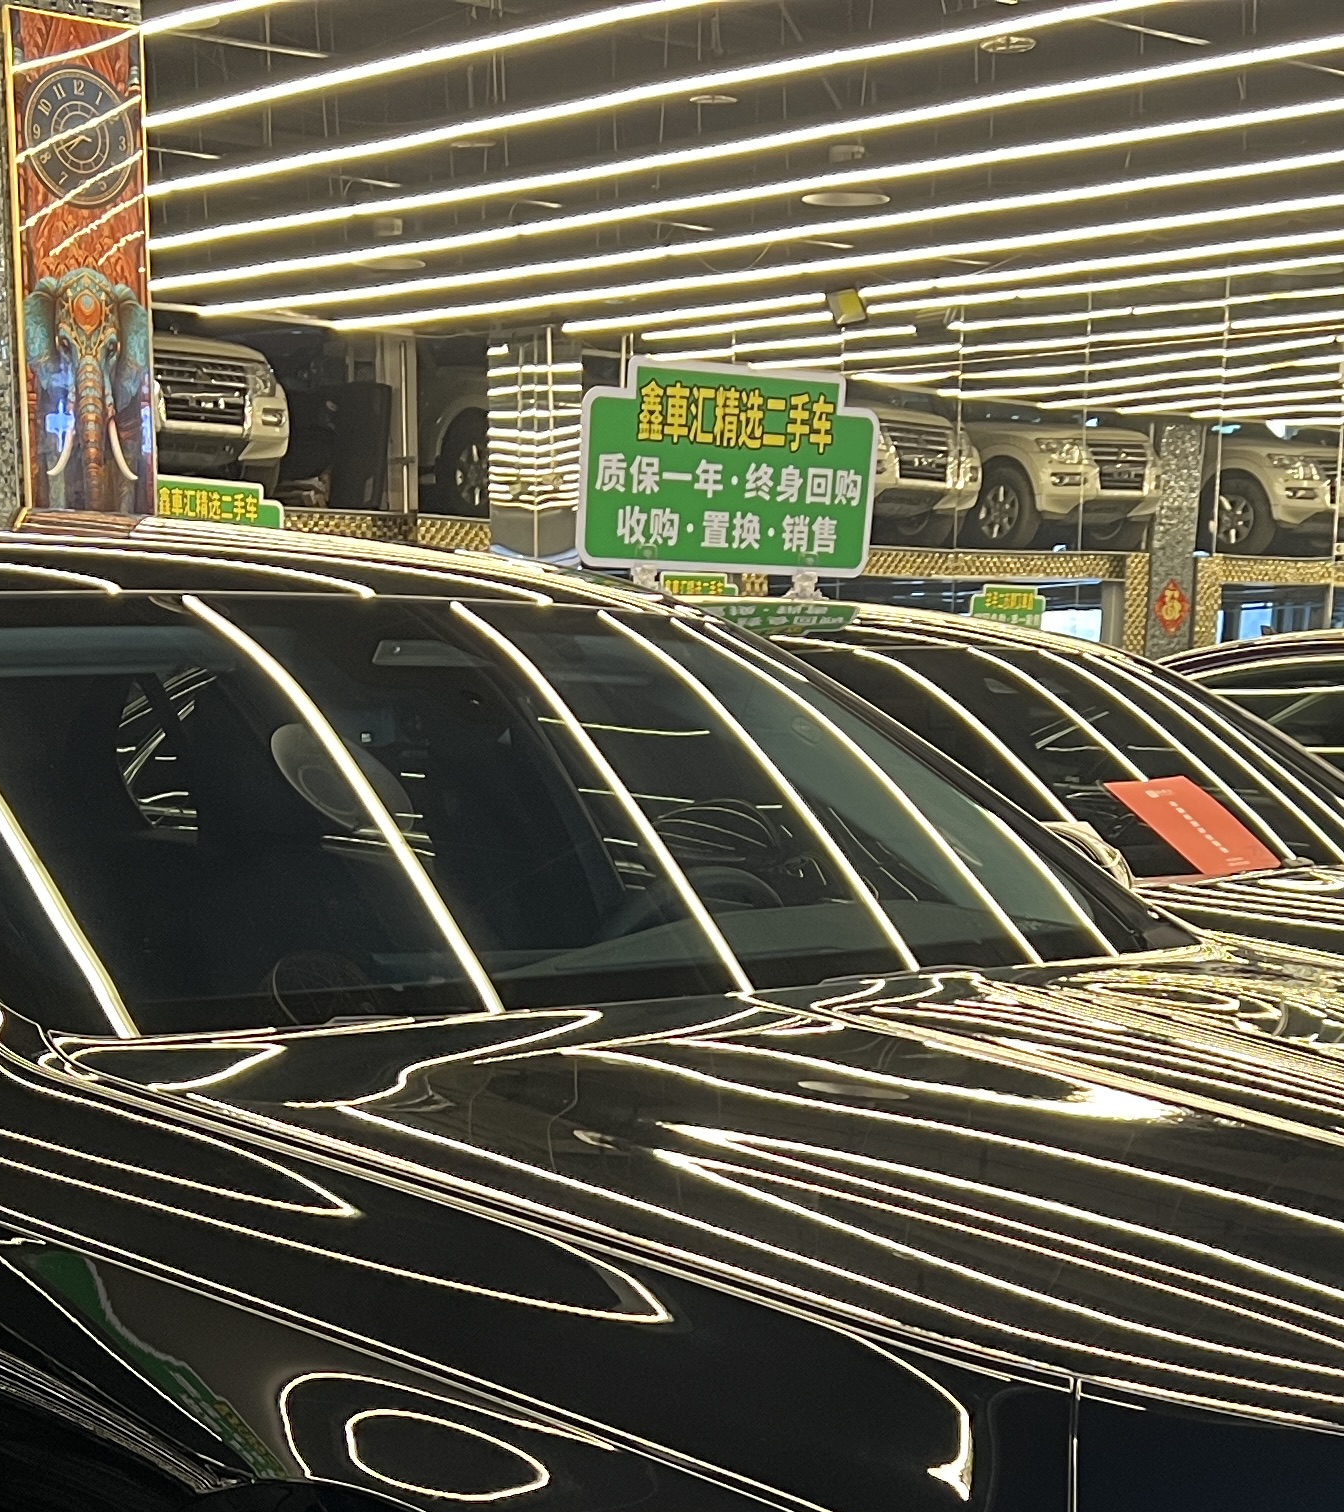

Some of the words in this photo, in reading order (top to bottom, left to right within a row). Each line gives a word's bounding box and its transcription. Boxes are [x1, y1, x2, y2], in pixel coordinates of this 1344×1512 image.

[52, 82, 67, 100] 11
[73, 79, 85, 96] 12
[37, 98, 53, 117] 10
[32, 123, 41, 139] 9
[118, 135, 127, 151] 3
[637, 378, 836, 455] 鑫車汇精选二手车
[594, 452, 863, 507] 质保一年·终身回购
[158, 486, 258, 522] 鑫車汇精选二手车
[616, 505, 838, 554] 收购·置换·销售
